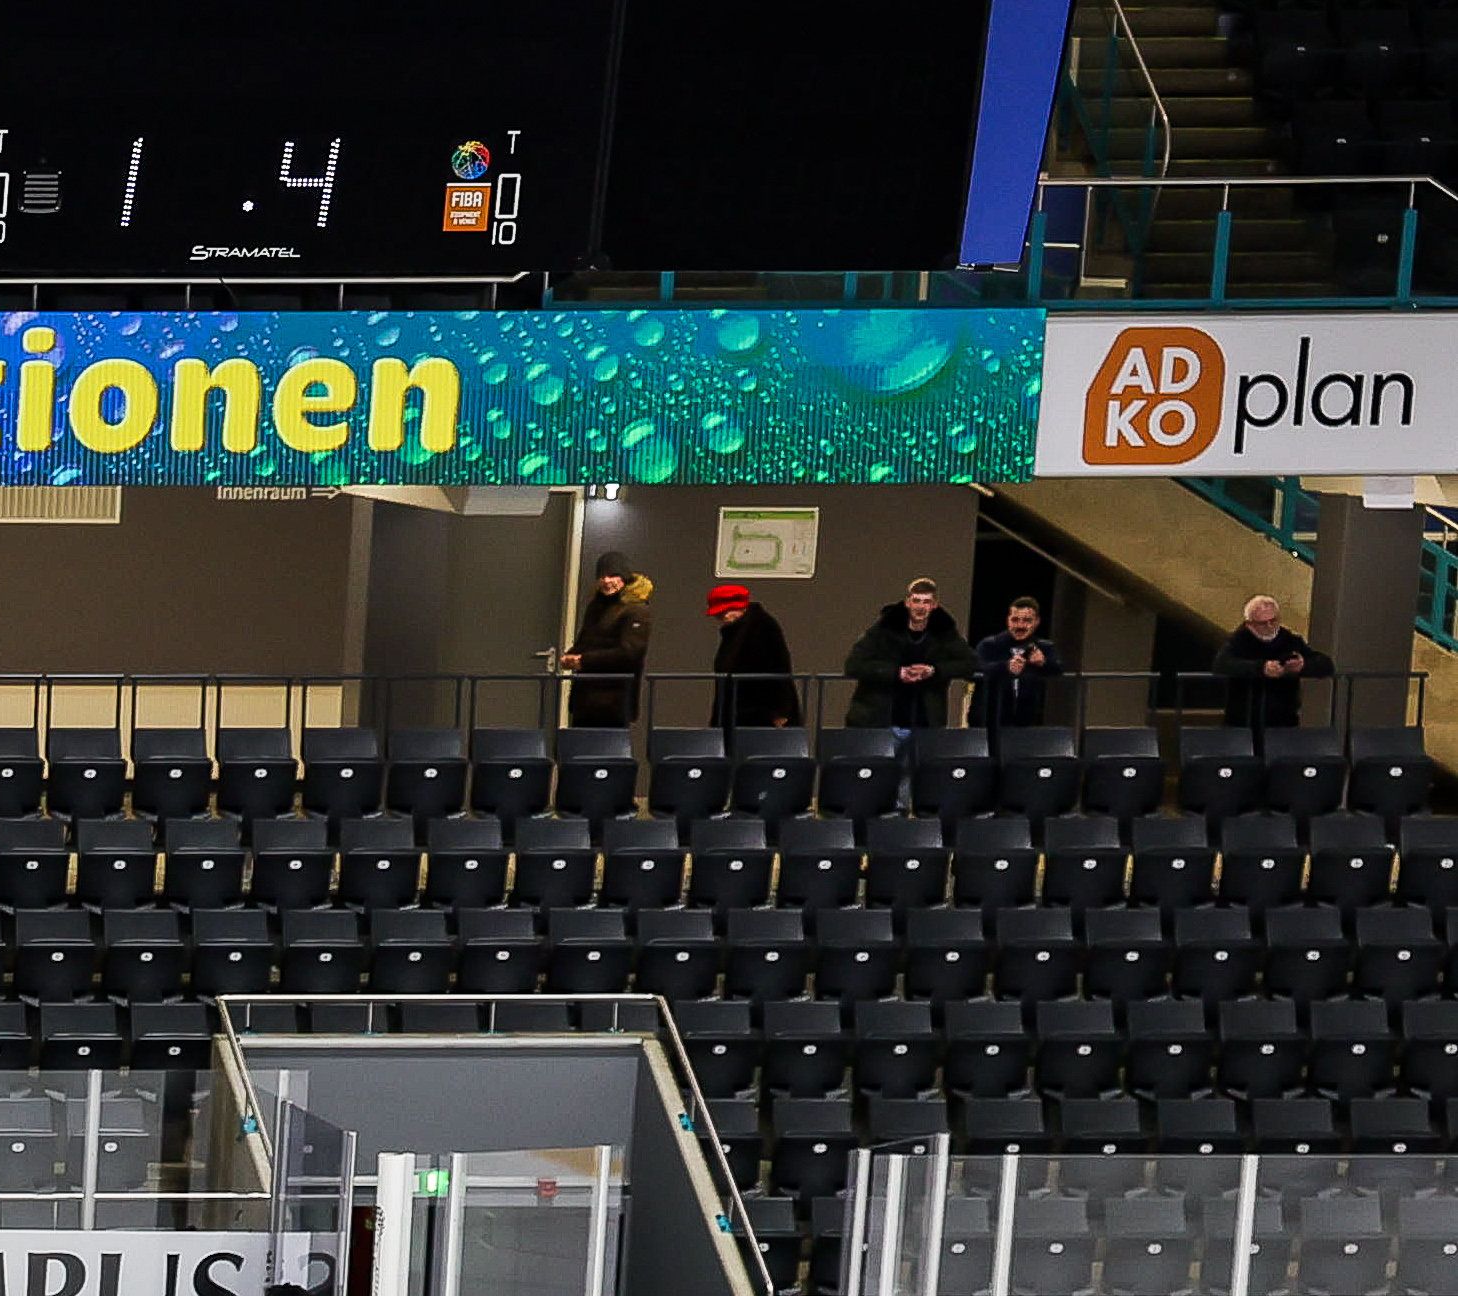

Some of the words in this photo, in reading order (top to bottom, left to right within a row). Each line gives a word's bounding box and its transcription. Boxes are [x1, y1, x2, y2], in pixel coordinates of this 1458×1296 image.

[451, 191, 483, 208] FIBA
[189, 244, 301, 261] STRAMATEL
[1235, 336, 1414, 456] plan
[216, 485, 307, 501] Innenraum
